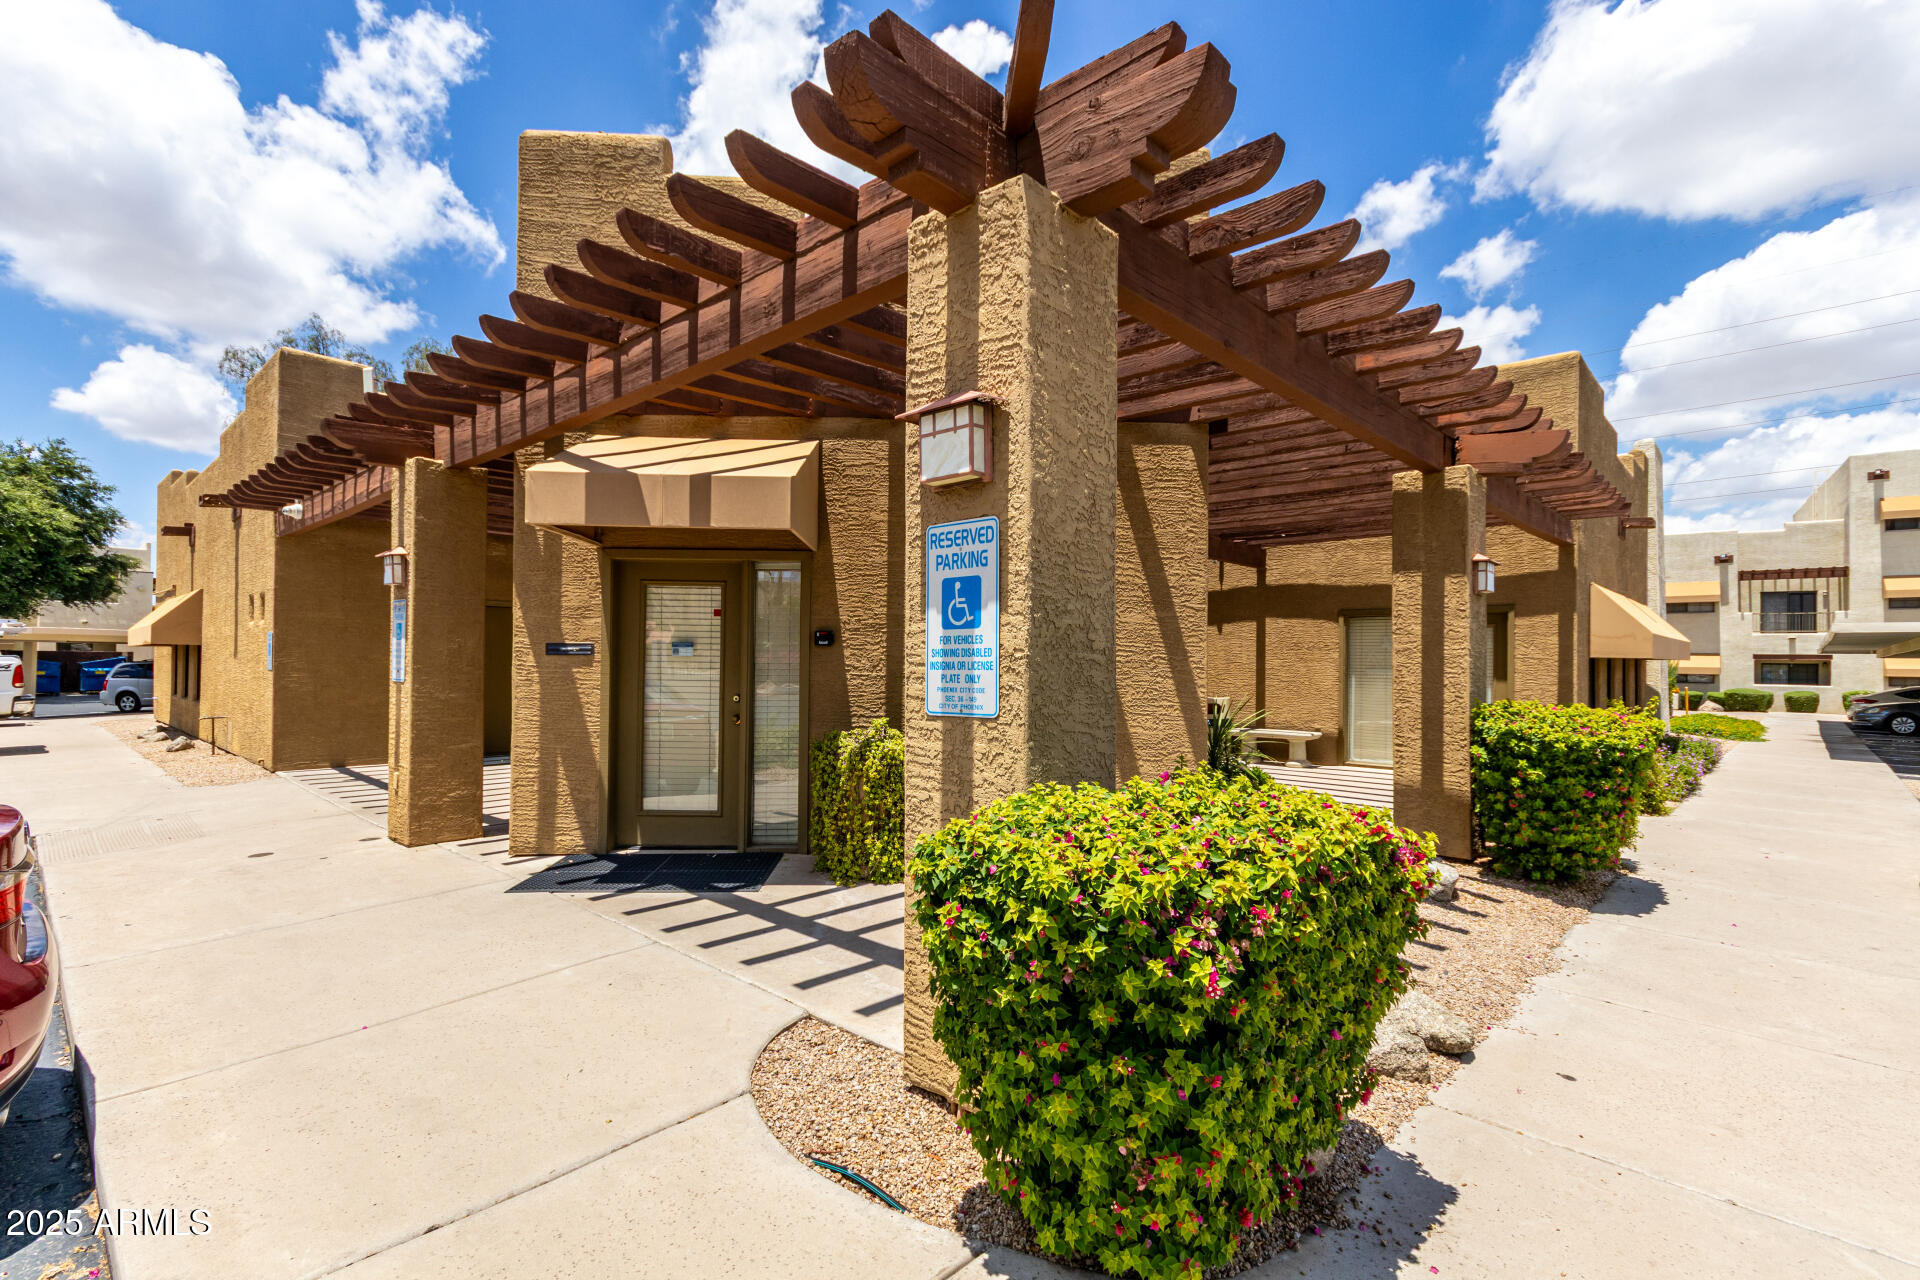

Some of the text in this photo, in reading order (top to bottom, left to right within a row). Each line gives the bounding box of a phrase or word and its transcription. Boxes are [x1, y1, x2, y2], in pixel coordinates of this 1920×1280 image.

[930, 525, 995, 550] RESERVED
[935, 549, 989, 571] PARKING
[939, 634, 984, 645] FOR VEHICLES
[931, 647, 993, 658] SHOWING DISABLED
[929, 660, 994, 671] INSIGNIA OR LICENSE
[940, 673, 981, 684] PLATE ONLY
